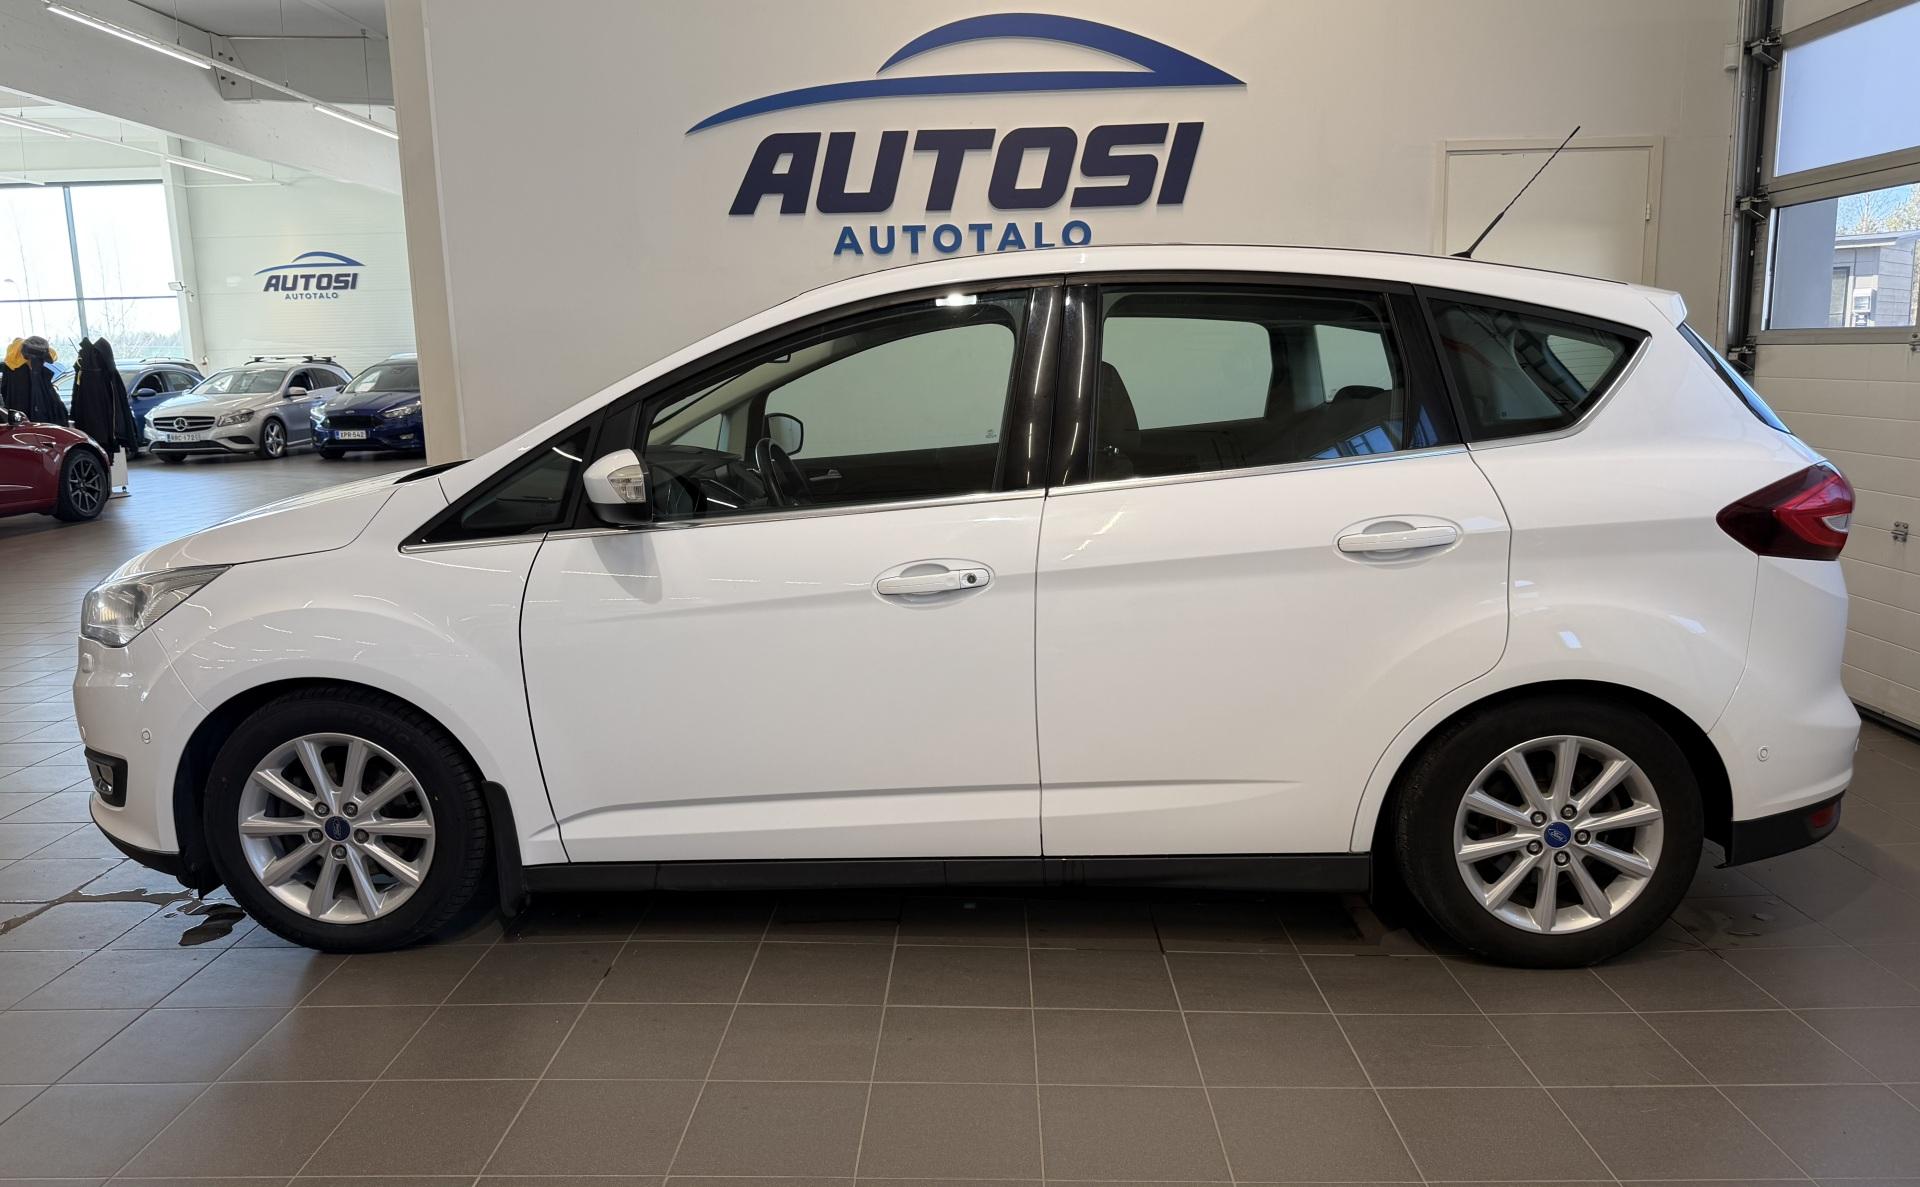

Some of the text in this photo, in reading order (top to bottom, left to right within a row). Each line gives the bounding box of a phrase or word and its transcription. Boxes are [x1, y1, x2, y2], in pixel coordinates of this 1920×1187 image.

[728, 121, 1205, 215] AUTOSI
[833, 220, 1092, 255] AUTOTALO
[263, 272, 358, 292] AUTOSI
[284, 291, 339, 300] AUTOTALO
